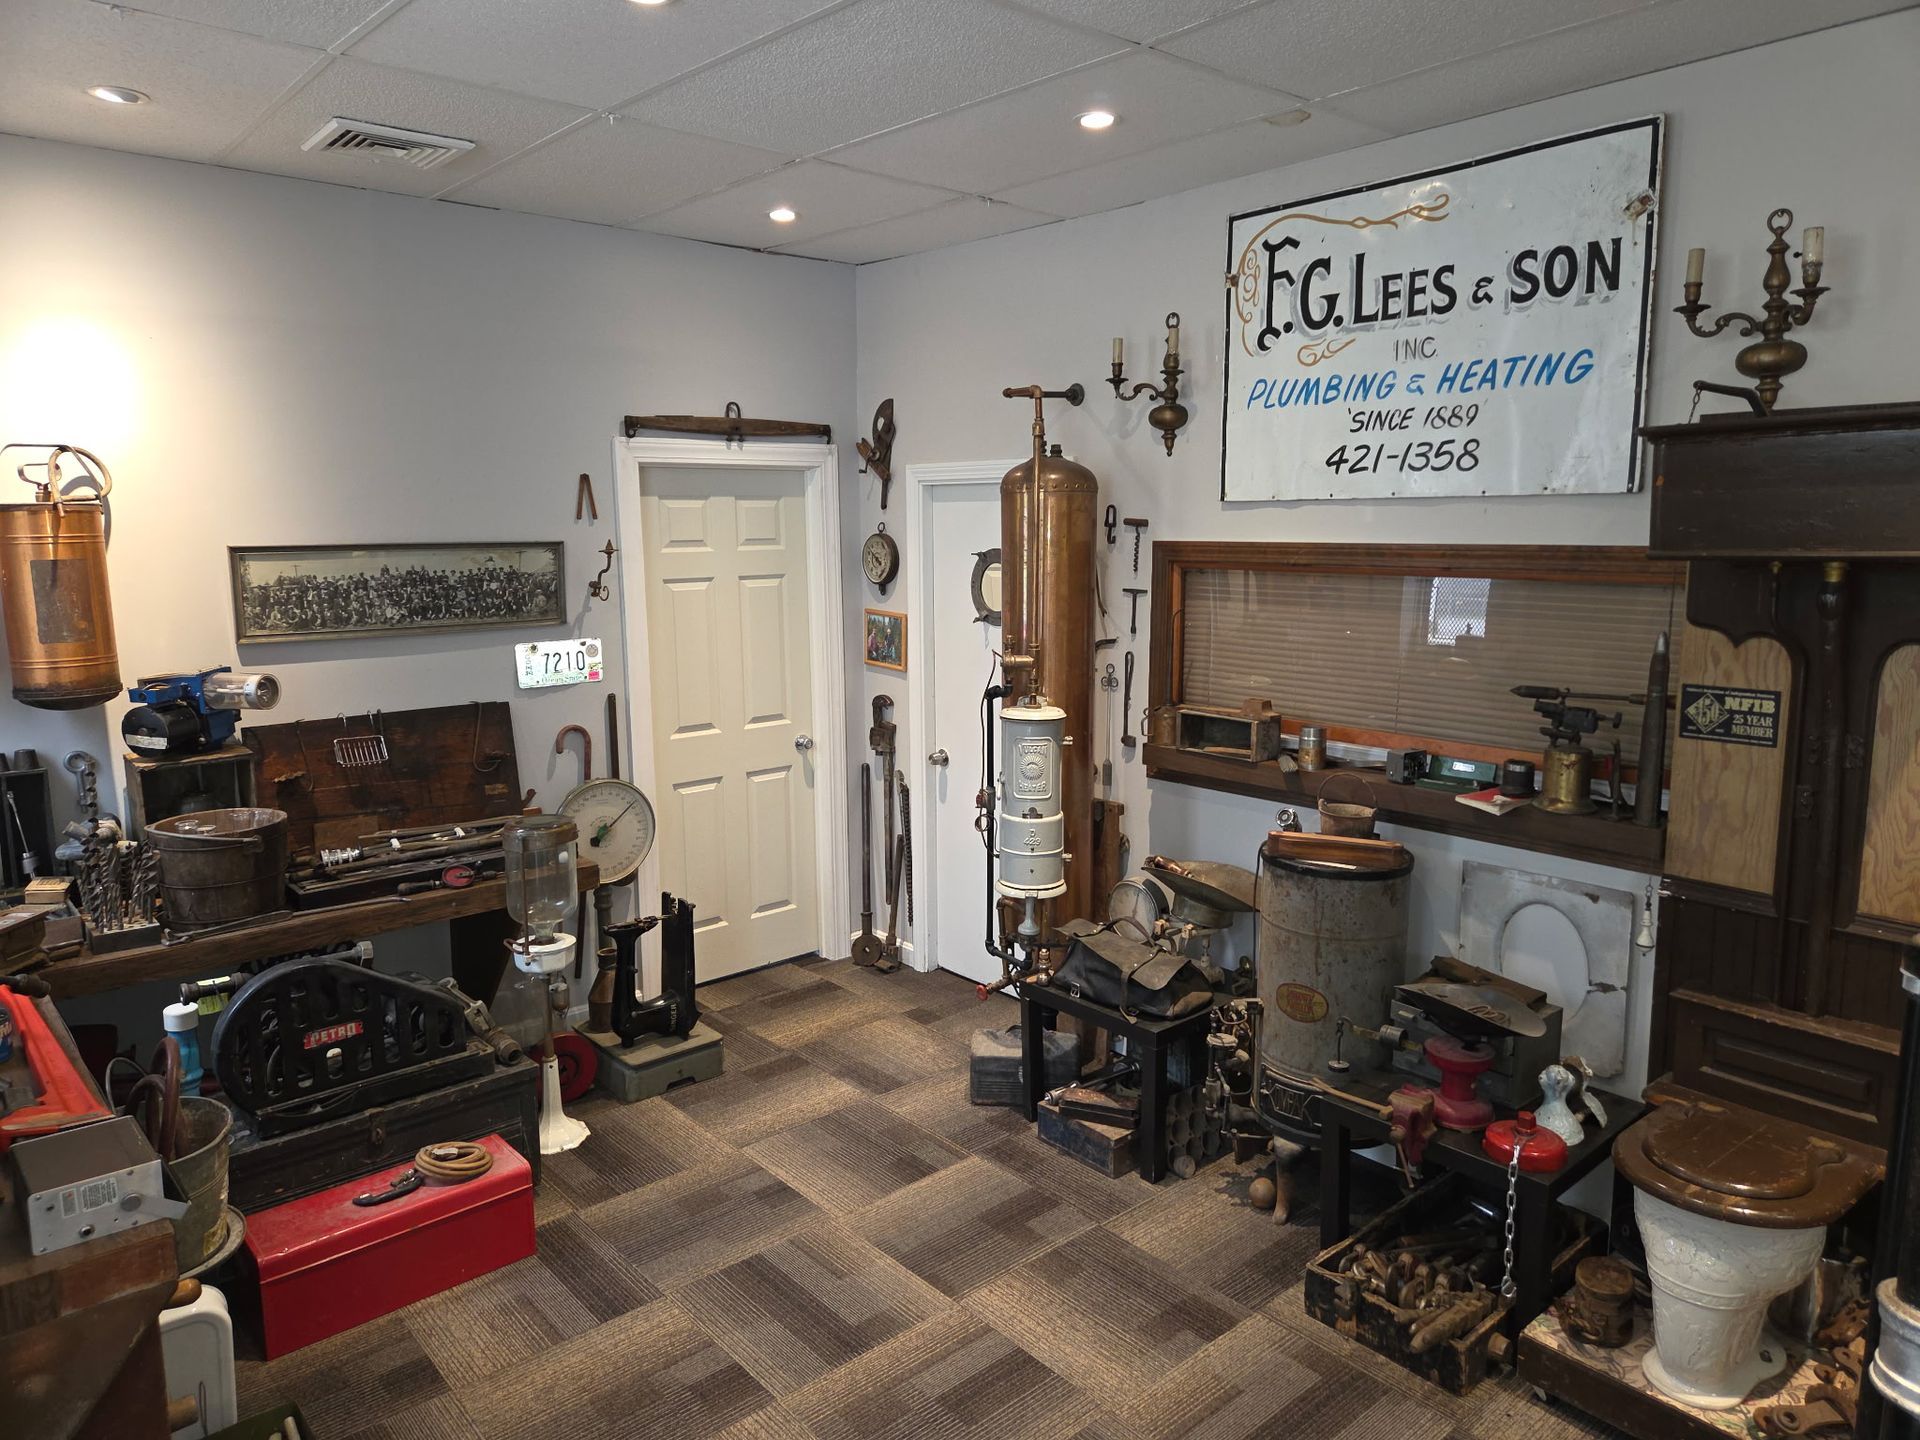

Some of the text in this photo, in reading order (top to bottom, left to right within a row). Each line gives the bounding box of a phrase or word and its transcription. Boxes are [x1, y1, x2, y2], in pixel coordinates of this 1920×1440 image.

[1471, 275, 1494, 306] &
[1509, 236, 1623, 305] SON
[1247, 348, 1594, 410] PLUMBING & HEATING
[1325, 438, 1480, 475] 421-1358
[543, 650, 585, 674] 7210
[1723, 696, 1776, 714] NFIB
[1731, 724, 1774, 738] MEMBER
[1732, 713, 1773, 727] 25 YEAR
